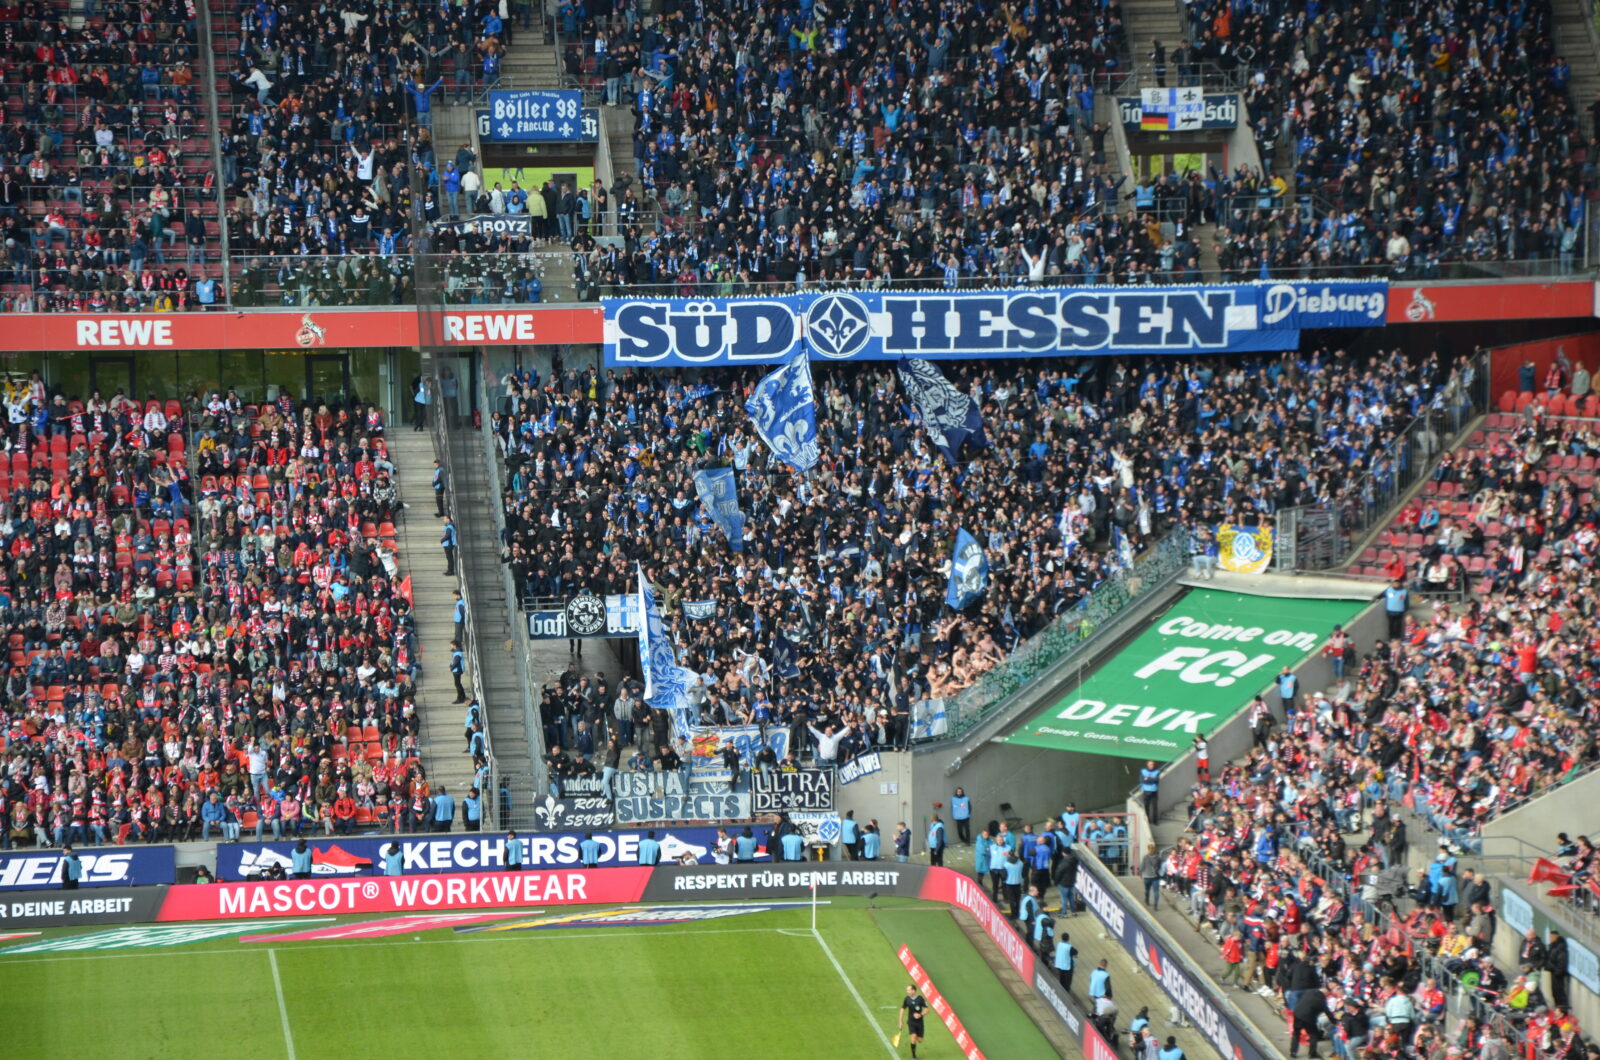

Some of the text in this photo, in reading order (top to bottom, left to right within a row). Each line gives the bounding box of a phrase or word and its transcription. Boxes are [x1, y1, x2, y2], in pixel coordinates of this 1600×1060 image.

[495, 98, 577, 119] Böller 98
[1263, 284, 1385, 324] Dieburg
[76, 320, 173, 346] REWE
[443, 314, 535, 341] REWE
[615, 290, 1235, 361] SÜD HESSEN
[1158, 616, 1318, 652] Come on,
[1133, 646, 1275, 687] FC!
[1057, 700, 1216, 734] DEVK
[614, 770, 690, 797] USUA
[755, 772, 830, 793] ULTRA
[617, 795, 740, 822] SUSPECTS
[756, 792, 831, 809] DE LIS
[564, 812, 614, 827] SEVEN
[378, 834, 640, 870] SKECHERSDE
[390, 874, 587, 906] WORKWEAR
[675, 870, 899, 890] RESPEKT FÜR DEINE ARBEIT
[12, 901, 65, 917] DEINE
[69, 898, 133, 914] ARBEIT
